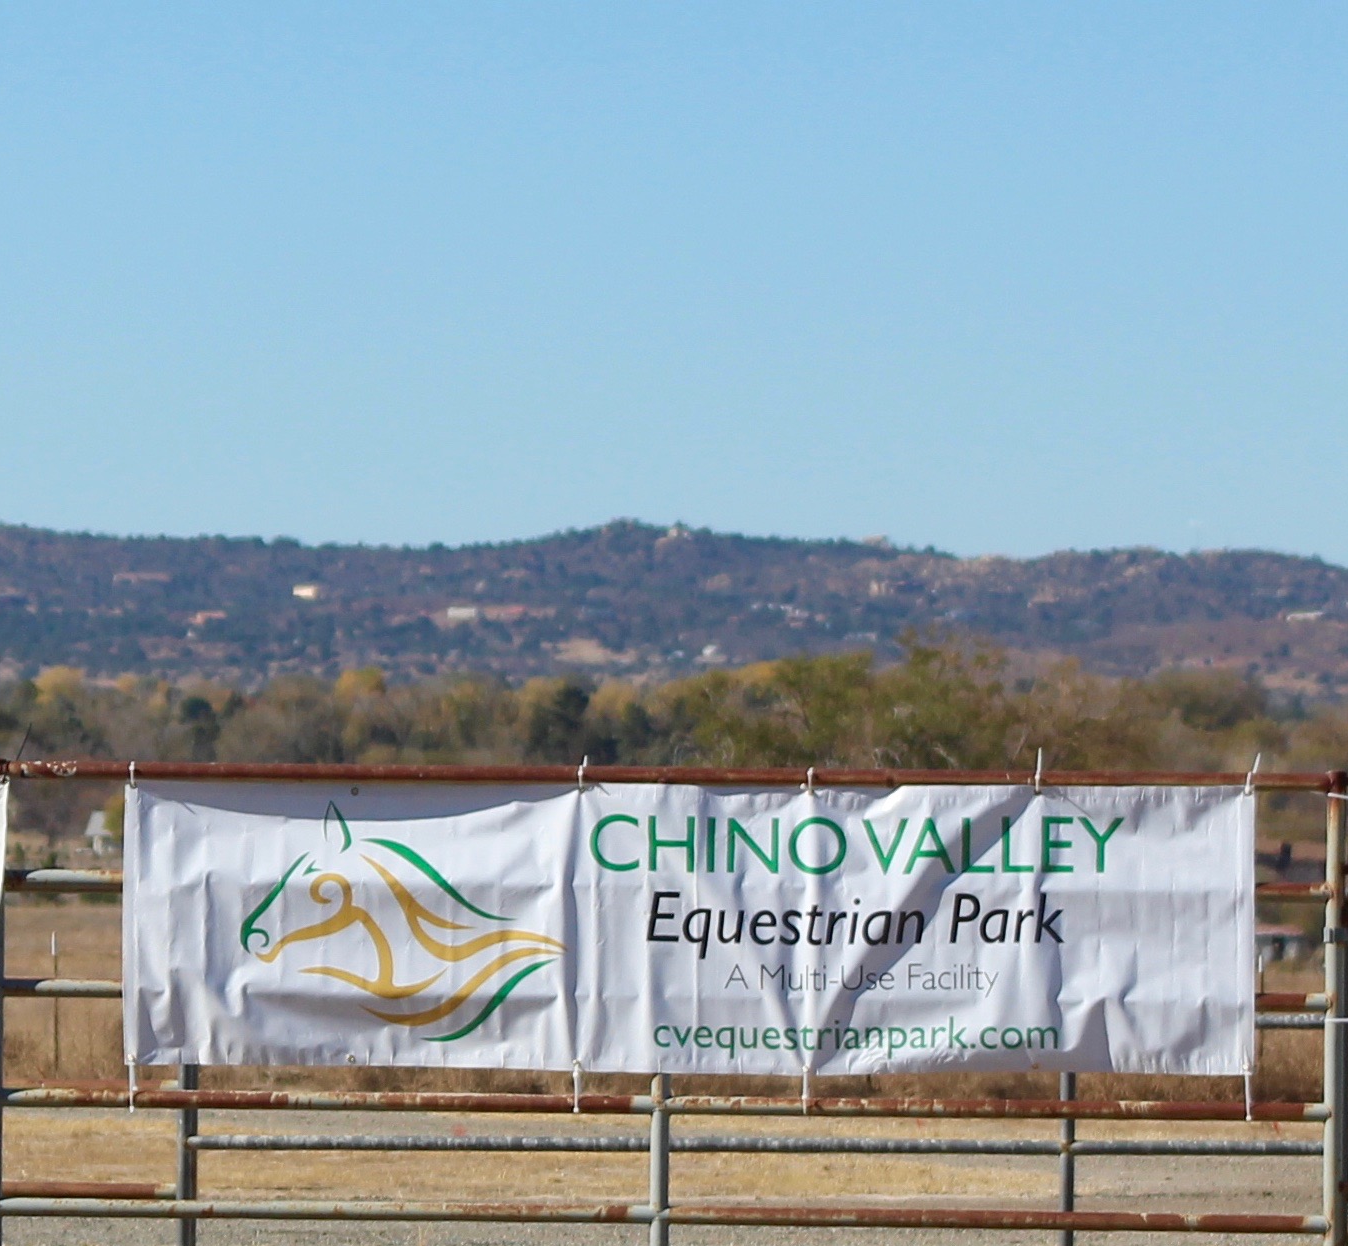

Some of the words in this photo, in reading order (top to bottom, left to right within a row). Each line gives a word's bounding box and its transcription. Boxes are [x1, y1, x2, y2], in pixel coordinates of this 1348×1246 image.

[589, 813, 847, 876] CHINO
[862, 815, 1125, 876] VALLEY
[646, 890, 926, 960] Equestrian
[949, 892, 1066, 946] Park
[725, 964, 749, 990] A
[760, 964, 896, 992] Multi-Use
[907, 963, 1000, 998] Facility
[653, 1016, 1060, 1060] cvequestrianpark.com
